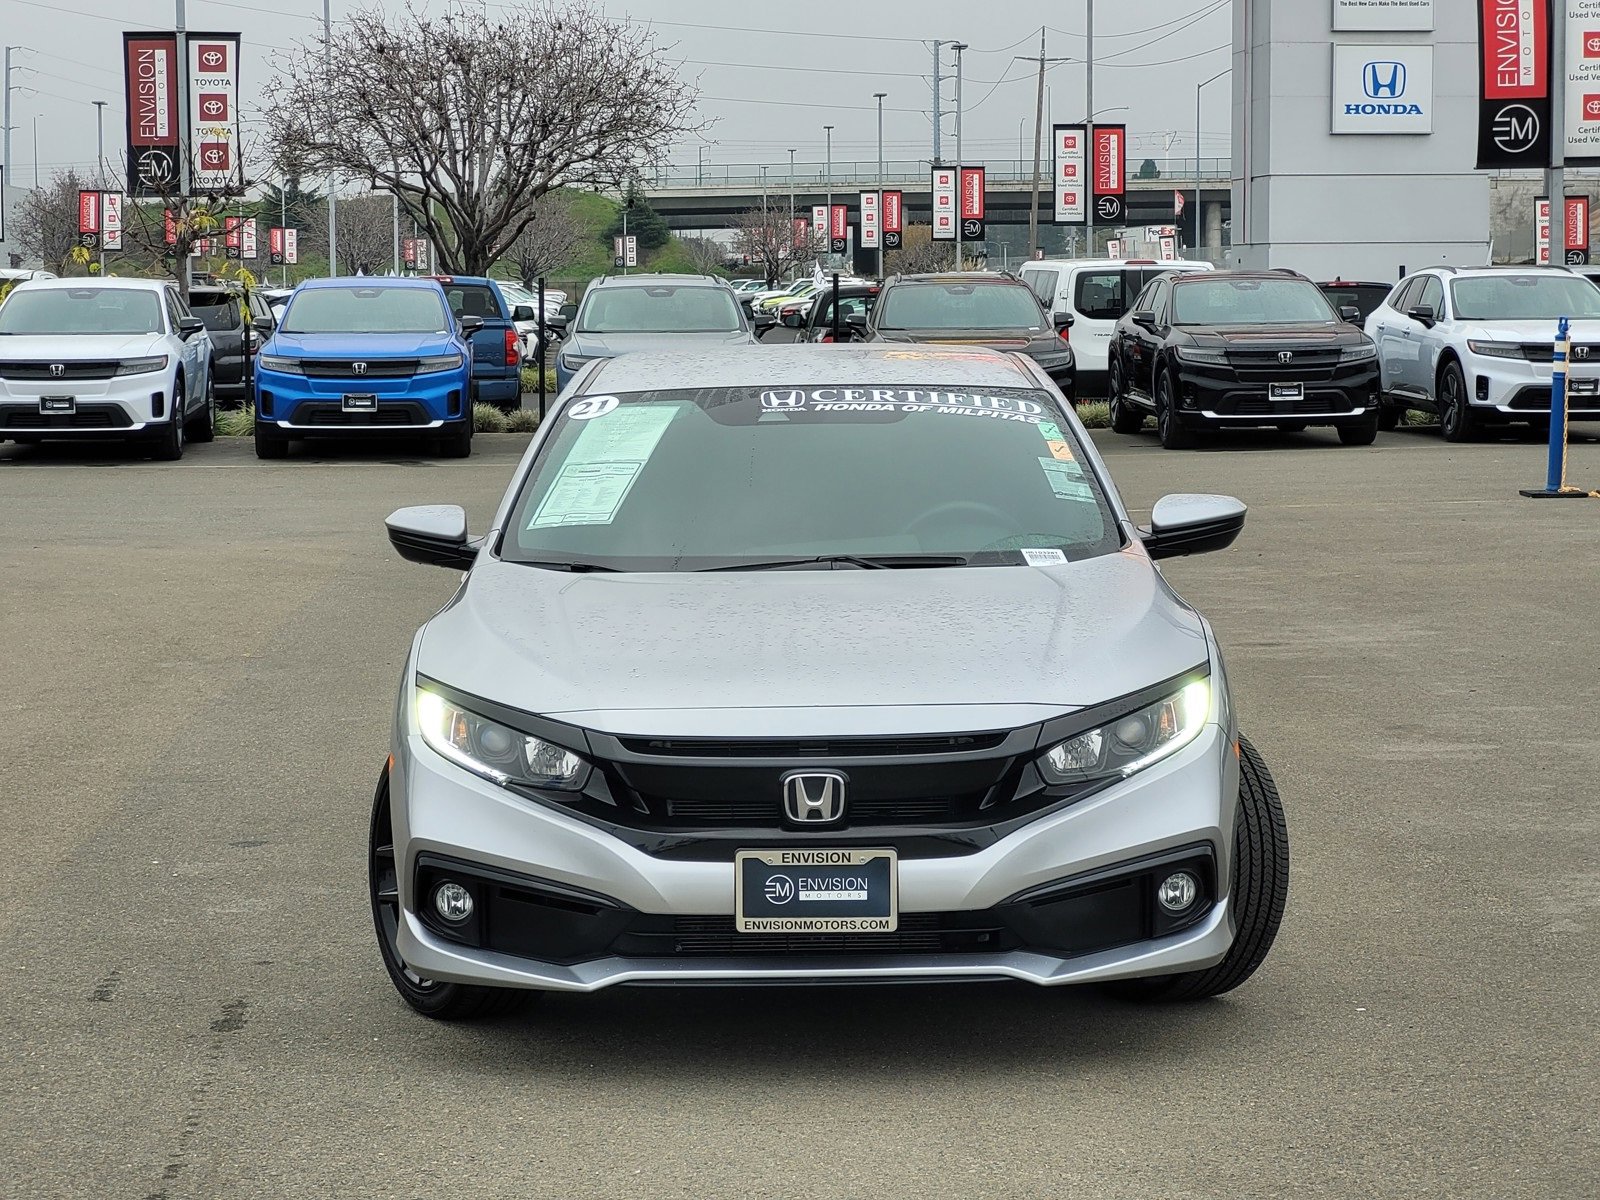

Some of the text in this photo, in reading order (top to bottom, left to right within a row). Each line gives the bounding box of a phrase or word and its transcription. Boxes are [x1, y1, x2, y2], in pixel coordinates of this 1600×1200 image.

[1496, 0, 1517, 87] ENVISI
[138, 49, 156, 137] ENVISION
[194, 79, 232, 87] TOYOTA
[158, 57, 167, 130] MOTORS
[1344, 104, 1424, 114] HONDA
[1100, 134, 1110, 189] ENVISION
[966, 174, 974, 214] ENVISION
[1148, 226, 1173, 236] FedEx
[1569, 204, 1577, 246] ENVISION
[571, 399, 610, 416] 21
[811, 389, 1042, 414] CERTIFIED
[902, 404, 934, 412] OF
[937, 406, 1042, 424] MILPITAS
[782, 852, 852, 864] ENVISION
[798, 878, 868, 890] ENVISION
[744, 920, 890, 930] ENVISIONMOTORS.COM
